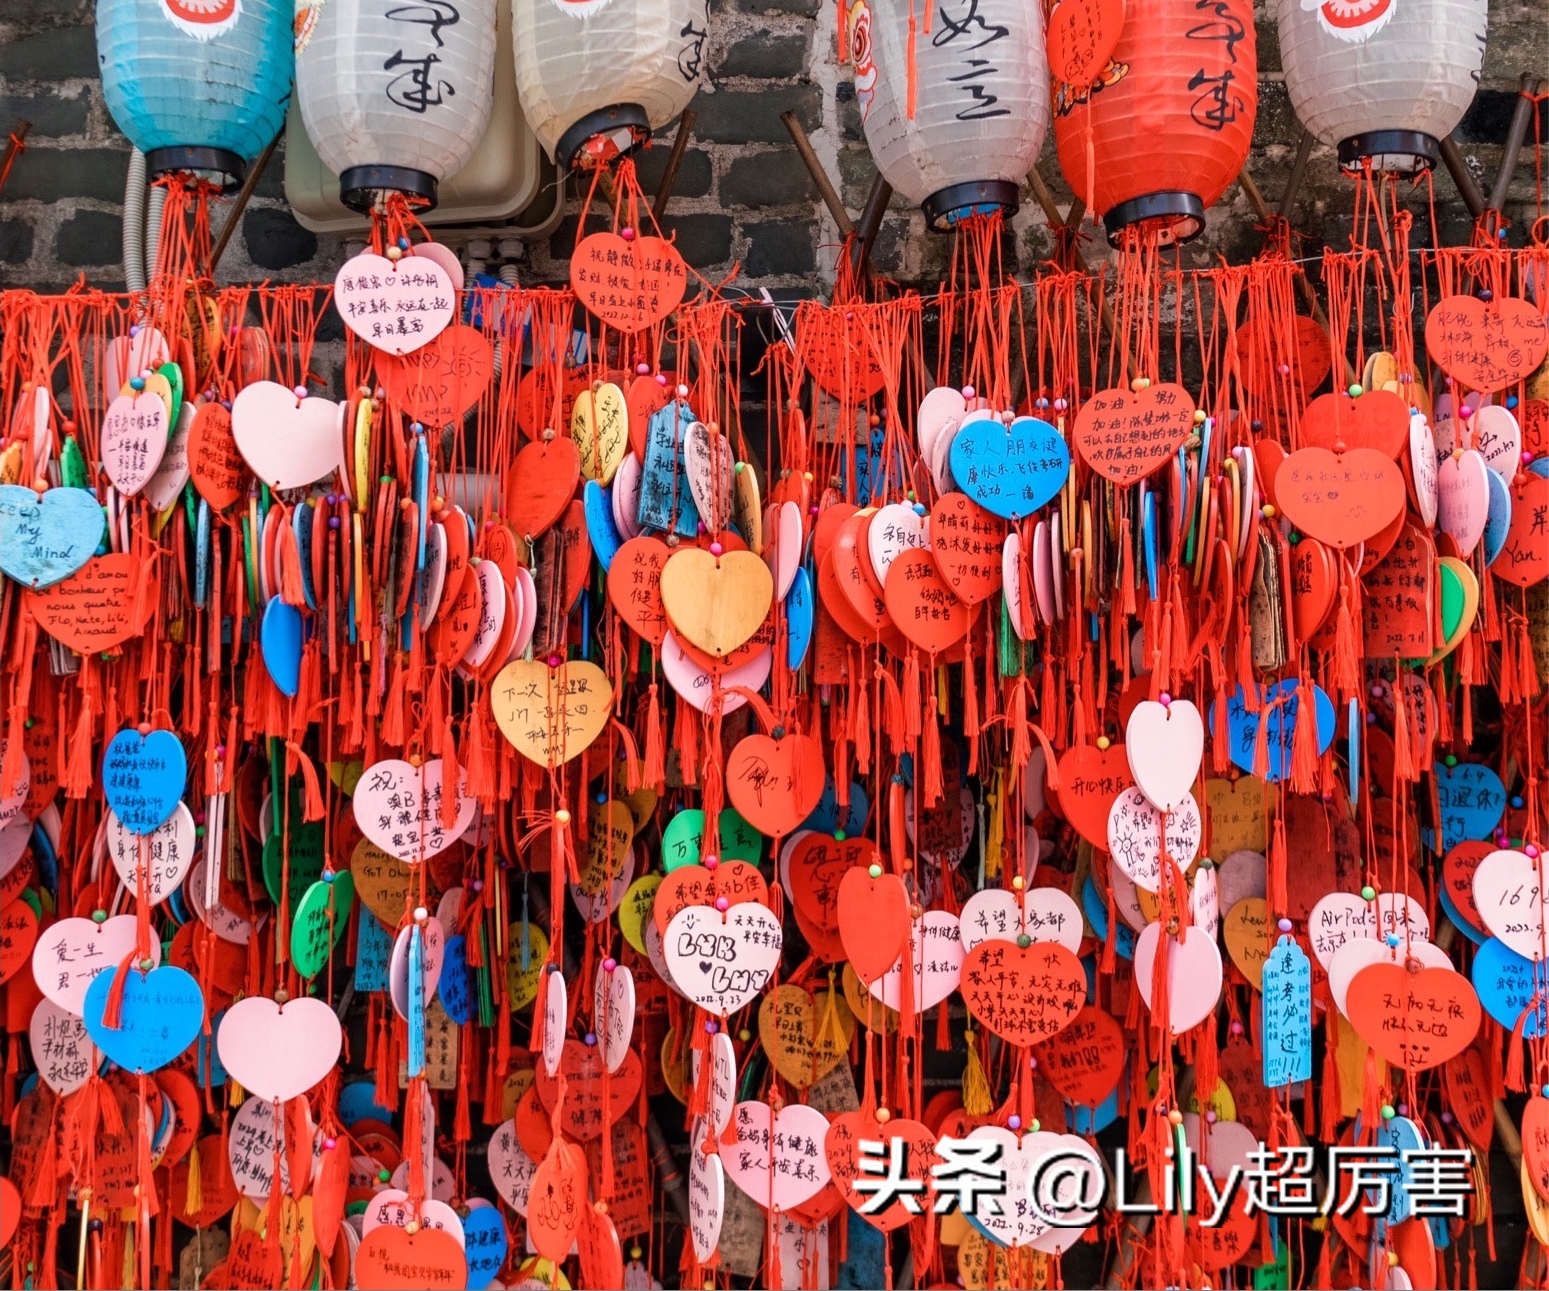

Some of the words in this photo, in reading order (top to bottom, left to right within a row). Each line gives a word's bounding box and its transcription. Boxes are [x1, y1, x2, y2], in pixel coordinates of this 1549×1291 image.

[14, 522, 43, 542] My
[30, 544, 74, 560] Mind
[57, 583, 107, 598] bonheur
[46, 601, 77, 612] nous
